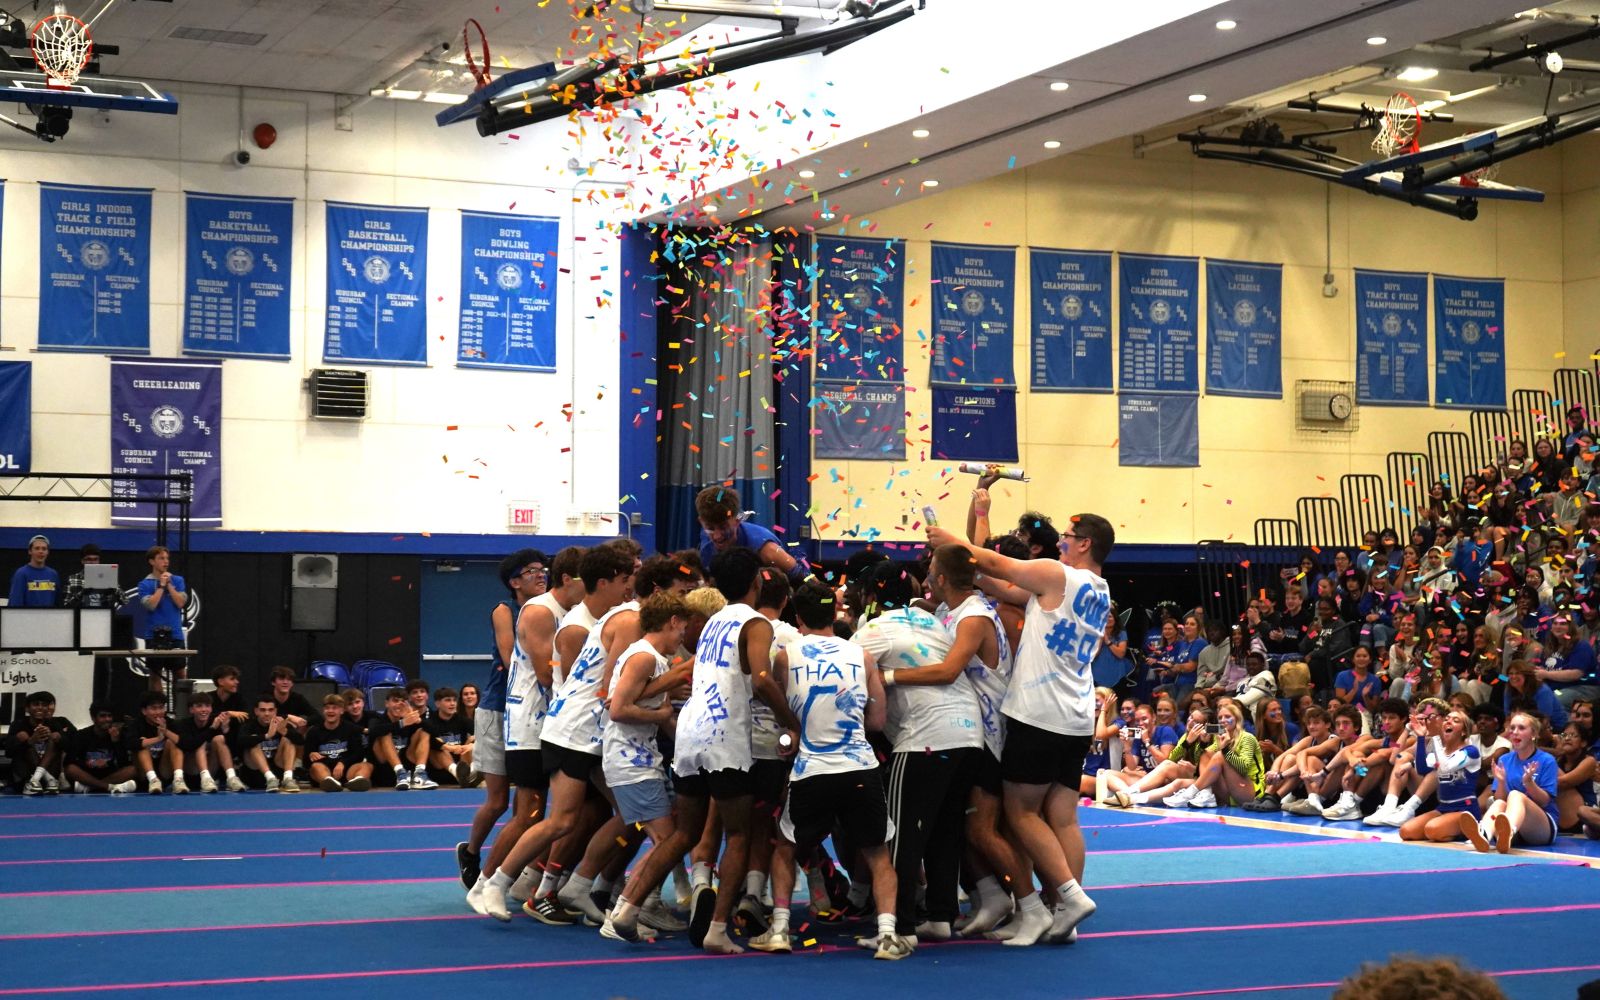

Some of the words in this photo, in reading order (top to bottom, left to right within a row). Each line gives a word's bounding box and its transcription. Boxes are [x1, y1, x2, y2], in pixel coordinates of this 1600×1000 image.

[61, 201, 90, 212] GIRLS
[96, 204, 133, 214] INDOOR
[57, 213, 90, 223] TRACK
[95, 215, 102, 224] &
[107, 216, 136, 226] FIELD
[228, 210, 252, 220] BOYS
[208, 220, 271, 232] BASKETBALL
[364, 220, 391, 230] GIRLS
[55, 224, 136, 238] CHAMPIONSHIPS
[348, 230, 408, 242] BASKETBALL
[499, 228, 521, 238] BOYS
[201, 230, 279, 244] CHAMPIONSHIPS
[340, 240, 415, 253] CHAMPIONSHIPS
[490, 238, 530, 250] BOWLING
[474, 248, 545, 262] CHAMPIONSHIPS
[964, 257, 984, 266] BOYS
[1061, 262, 1080, 271] BOYS
[954, 267, 993, 277] BASEBALL
[1056, 272, 1085, 281] TENNIS
[1150, 268, 1169, 277] BOYS
[943, 276, 1004, 288] CHAMPIONSHIPS
[1042, 281, 1102, 291] CHAMPIONSHIPS
[1141, 277, 1178, 287] LACROSSE
[1384, 282, 1401, 291] BOYS
[1130, 286, 1189, 297] CHAMPIONSHIPS
[1366, 291, 1389, 300] TRACK
[1398, 293, 1418, 301] FIELD
[523, 304, 547, 312] CHAMPS
[1365, 300, 1419, 311] CHAMPIONSHIPS
[1445, 298, 1466, 307] TRACK
[1476, 300, 1495, 308] FIELD
[1444, 307, 1496, 318] CHAMPIONSHIPS
[133, 379, 201, 390] CHEERLEADING
[865, 392, 897, 402] CHAMPS
[954, 396, 996, 405] CHAMPIONS
[122, 413, 142, 433] SHS
[193, 415, 211, 435] SHS
[515, 509, 534, 524] EXIT
[790, 659, 862, 685] THAT
[1, 671, 37, 686] Lights
